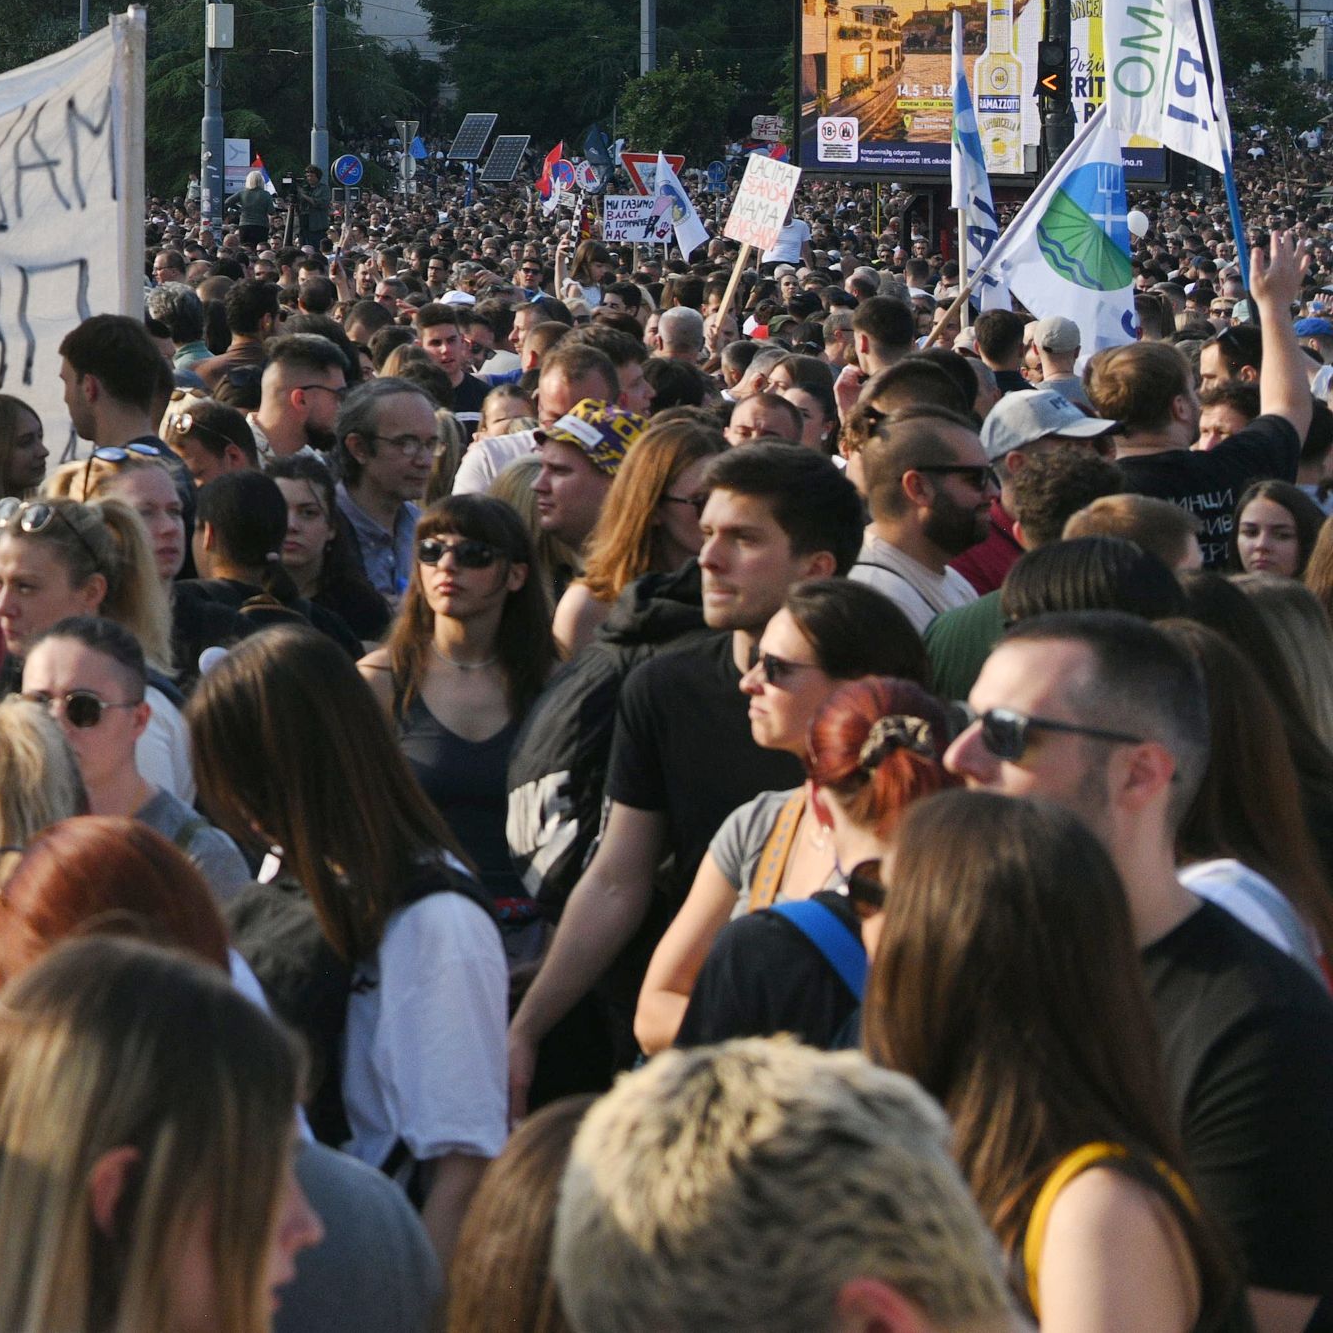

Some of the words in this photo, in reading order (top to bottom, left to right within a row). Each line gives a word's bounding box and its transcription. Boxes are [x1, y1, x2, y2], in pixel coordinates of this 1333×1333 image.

[896, 84, 919, 97] 14.5
[606, 200, 619, 210] МИ
[621, 199, 654, 210] ГАЗИМО
[606, 229, 628, 240] НАС
